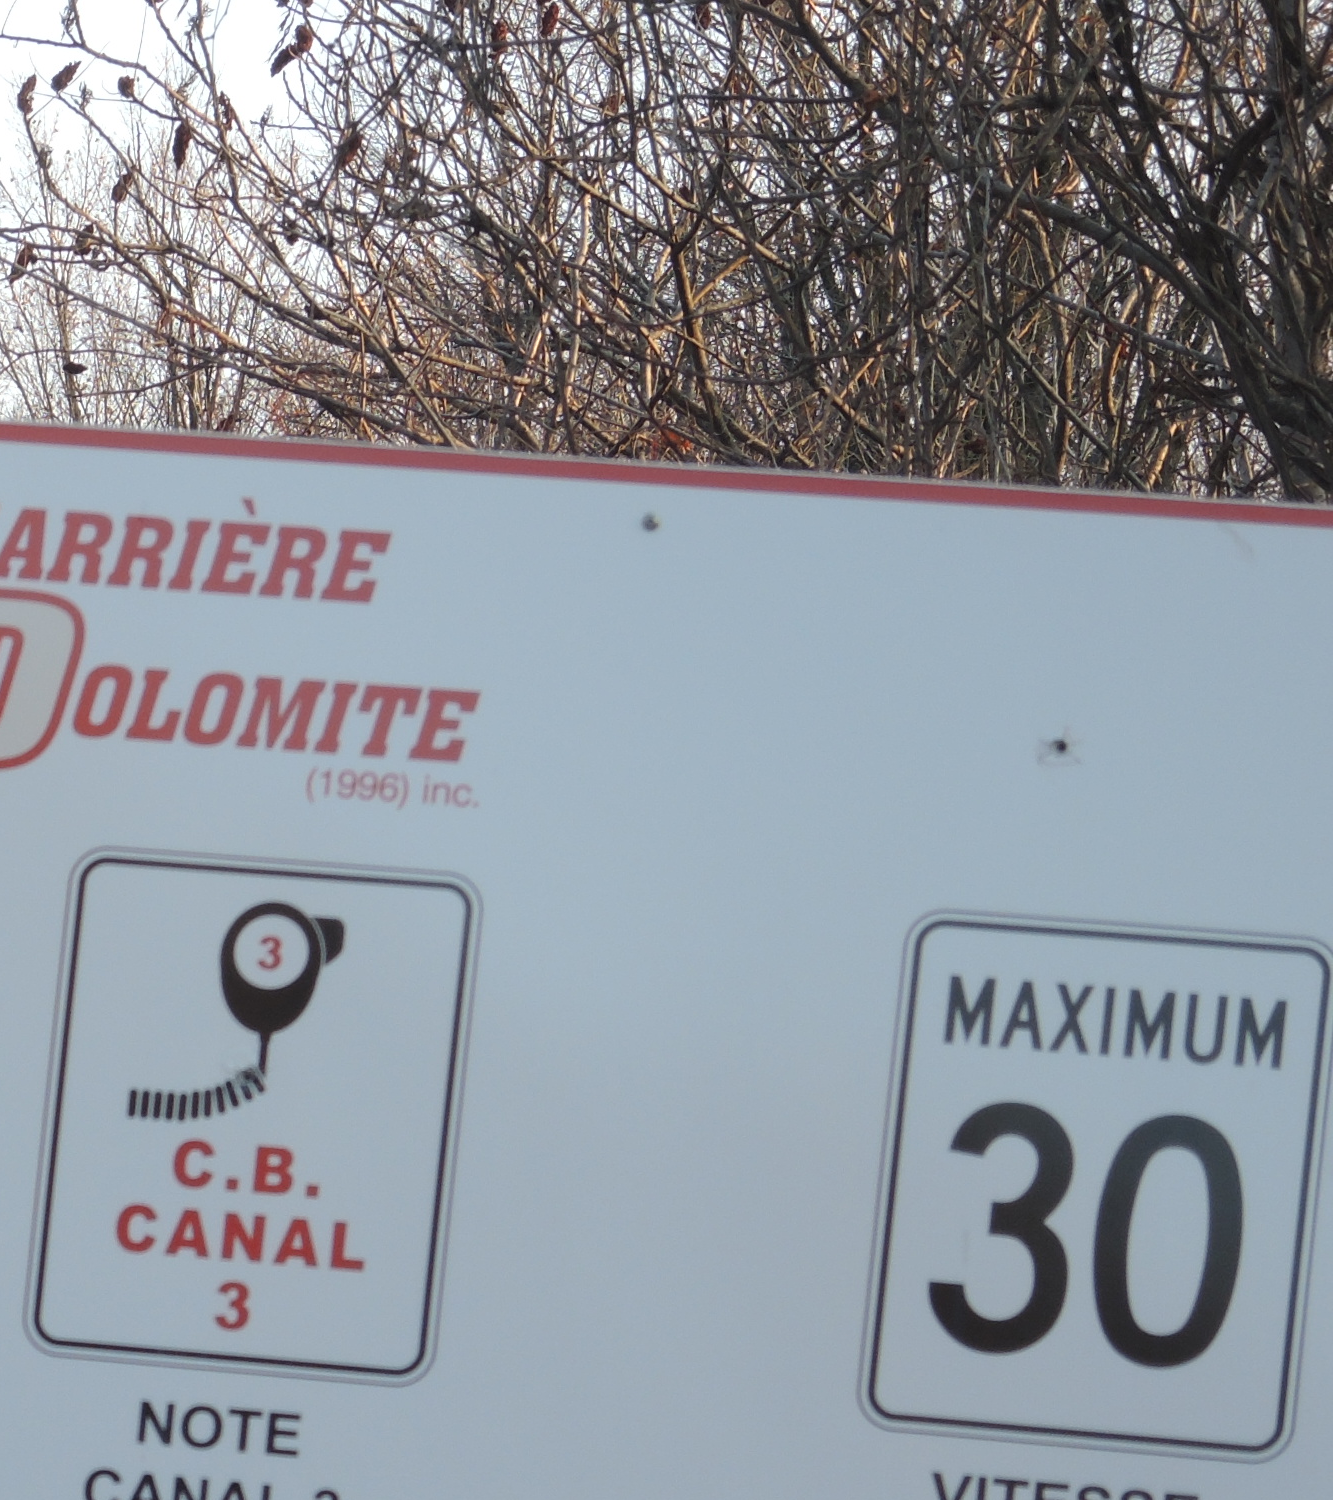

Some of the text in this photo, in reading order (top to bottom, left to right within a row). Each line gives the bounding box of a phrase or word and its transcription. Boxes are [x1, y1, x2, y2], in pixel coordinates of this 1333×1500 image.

[305, 767, 480, 811] (1996) inc.
[257, 935, 284, 971] 3
[943, 973, 1288, 1070] MAXIMUM
[173, 1139, 321, 1199] C.B.
[115, 1203, 366, 1272] CANAL
[928, 1100, 1244, 1369] 30
[214, 1281, 252, 1331] 3
[136, 1400, 303, 1458] NOTE
